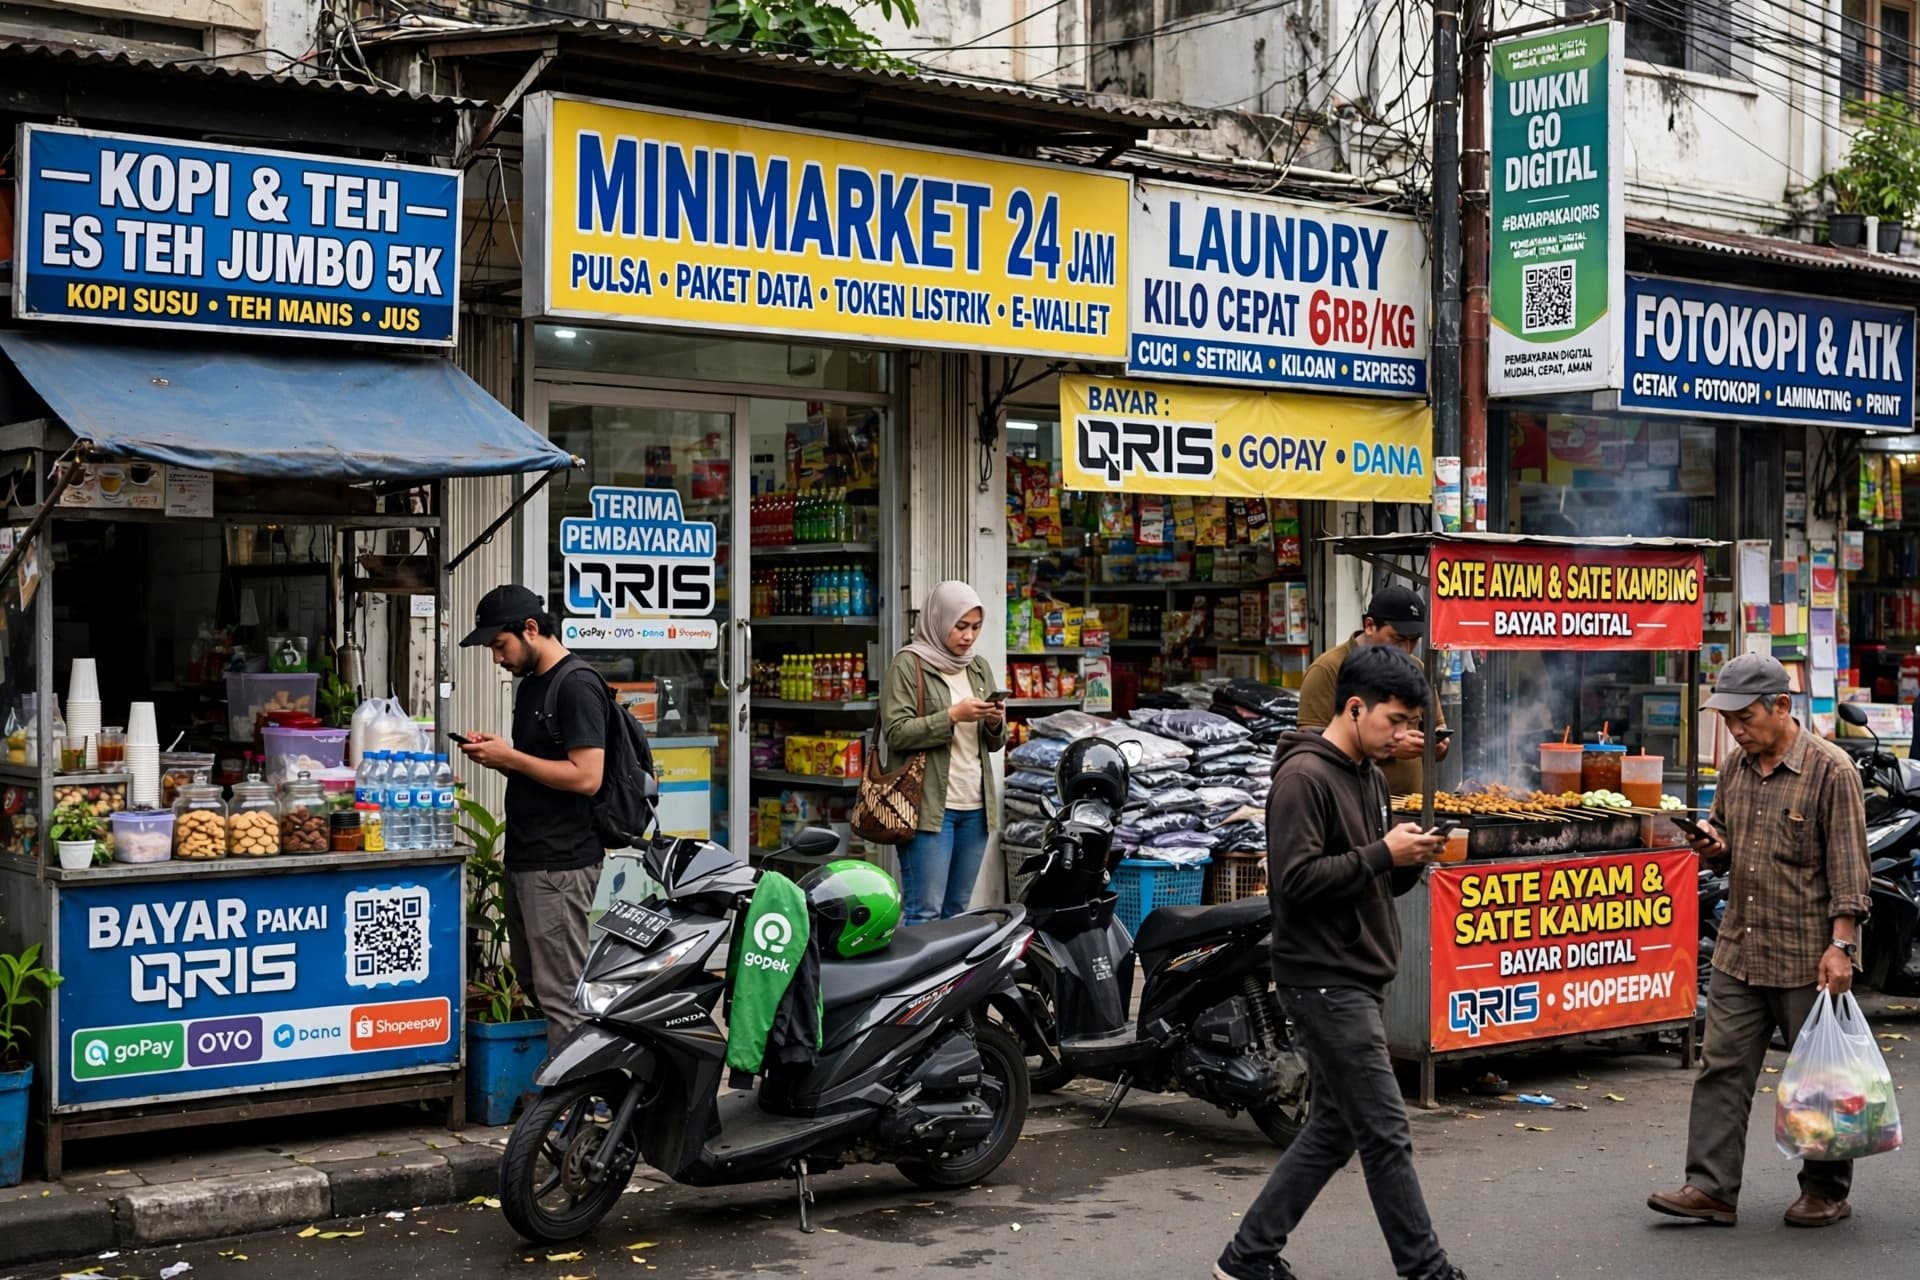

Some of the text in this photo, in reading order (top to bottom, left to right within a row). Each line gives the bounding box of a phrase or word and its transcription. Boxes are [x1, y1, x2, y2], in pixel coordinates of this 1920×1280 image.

[1509, 68, 1588, 116] UMKM
[1528, 112, 1561, 150] GO
[100, 150, 399, 233] KOPI & TEH
[1506, 145, 1597, 192] DIGITAL
[578, 133, 1114, 285] MINIMARKET 24 JAM
[42, 213, 443, 296] ES TEH JUMBO 5K
[1170, 201, 1388, 290] LAUNDRY
[67, 283, 420, 331] KOPI SUSU TEH MANIS JUS
[572, 253, 1110, 335] PULSA PAKET DATA TOKEN LISTRIK E-WALLET
[1144, 278, 1415, 350] KILO CEPAT 6RB/KG
[1505, 348, 1592, 365] PEMBAYARAN DIGITAL
[1636, 294, 1903, 382] FOTOKOPI & ATK
[1138, 340, 1416, 386] CUCI SETRIKA KILOAN EXPRESS
[1504, 361, 1592, 378] MUDAH, CEPAT, AMAN
[1633, 372, 1900, 416] CETAK FOTOKOPI LAMINATING PRINT
[1078, 419, 1424, 481] QRIS GOPAY DANA
[596, 494, 678, 521] TERIMA
[566, 525, 710, 553] PEMBAYARAN
[569, 562, 710, 618] QRIS
[1437, 560, 1698, 602] SATE AYAM & SATE KAMBING
[579, 628, 606, 639] GoPay
[614, 628, 634, 638] OVO
[1495, 612, 1632, 636] BAYAR DIGITAL
[1461, 863, 1663, 908] SATE AYAM &
[89, 898, 327, 948] BAYAR PAKAI
[1455, 896, 1672, 945] SATE KAMBING
[130, 942, 296, 1008] QRIS
[744, 951, 789, 974] gopek
[1500, 939, 1636, 976] BAYAR DIGITAL
[376, 1017, 442, 1034] Shopeepay
[1450, 971, 1674, 1035] QRIS SHOPEEPAY
[114, 1040, 174, 1062] goPay
[199, 1030, 252, 1052] OVO
